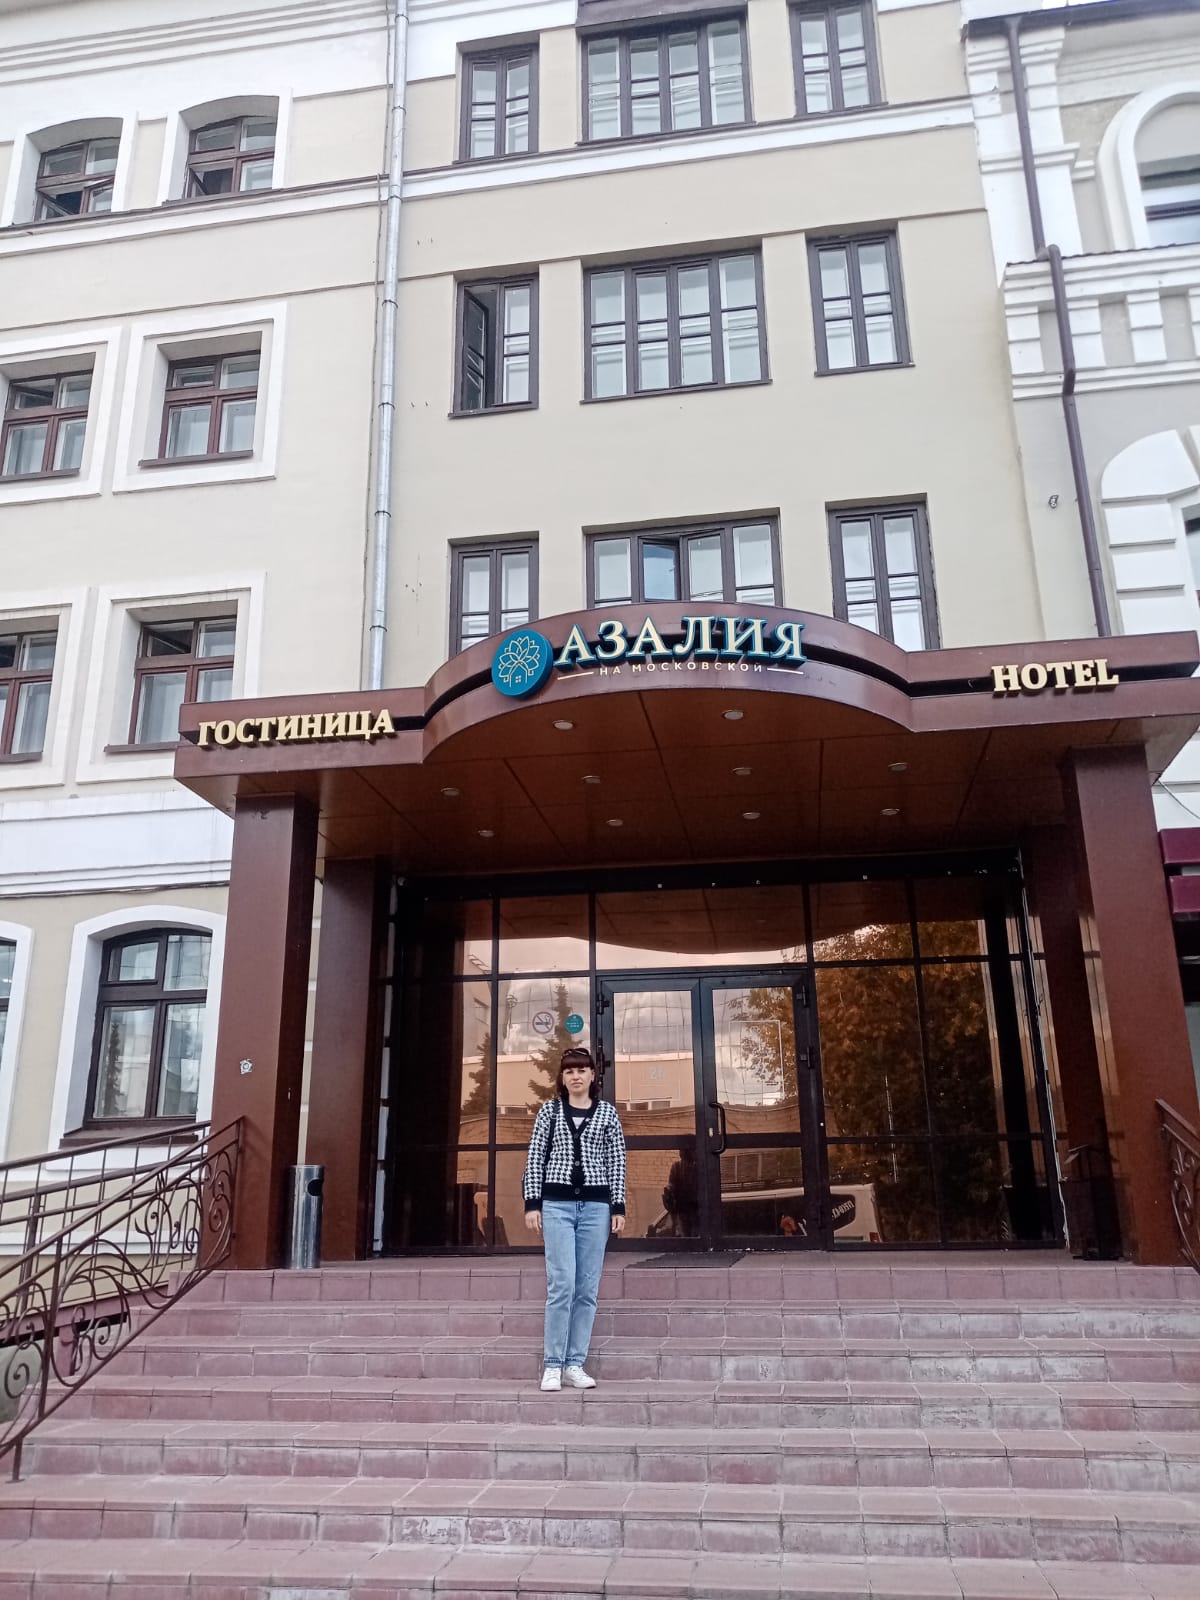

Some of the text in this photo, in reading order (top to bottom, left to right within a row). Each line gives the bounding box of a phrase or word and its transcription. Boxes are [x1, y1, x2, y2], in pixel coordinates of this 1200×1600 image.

[554, 616, 806, 667] АЗАЛИЯ
[600, 661, 762, 676] НА МОСКОВСКОЙ
[991, 658, 1119, 692] HOTEL
[197, 709, 395, 746] ГОСТИНИЦА
